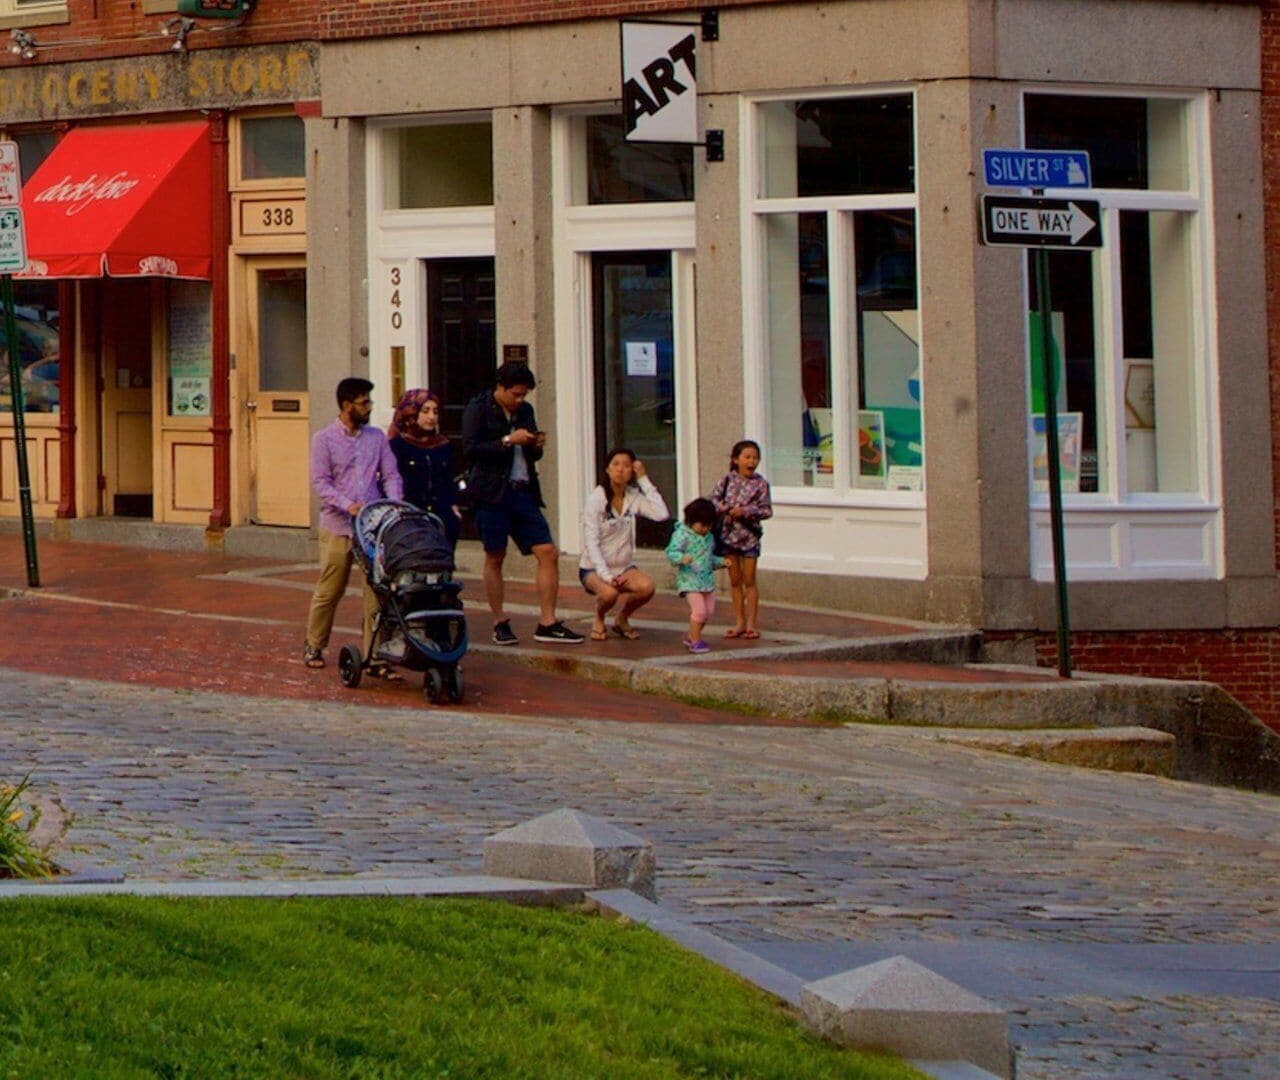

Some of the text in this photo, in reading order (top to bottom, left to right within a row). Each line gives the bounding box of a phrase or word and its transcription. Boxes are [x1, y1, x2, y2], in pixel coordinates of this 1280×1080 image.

[623, 32, 696, 139] ART
[990, 156, 1064, 182] SILVER ST
[262, 208, 294, 226] 338
[996, 210, 1073, 232] ONE WAY
[7, 233, 17, 241] TO
[391, 267, 402, 329] 340
